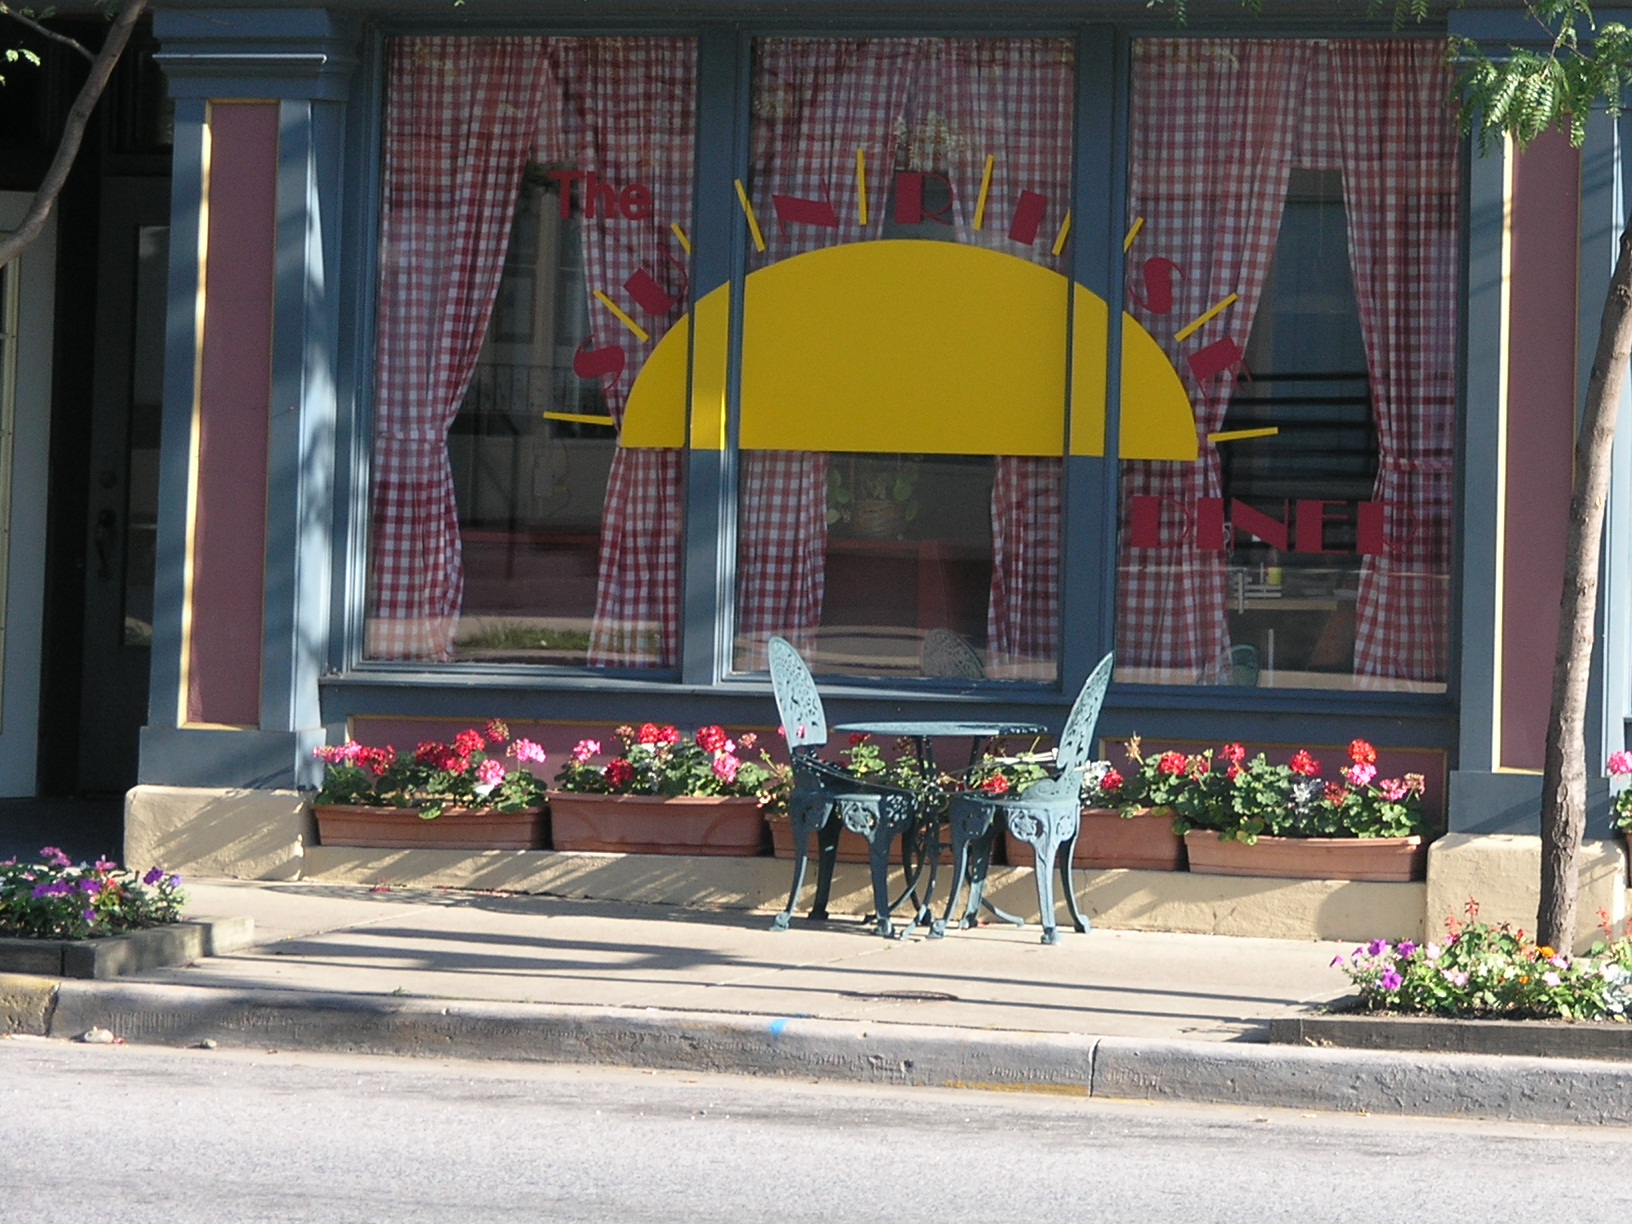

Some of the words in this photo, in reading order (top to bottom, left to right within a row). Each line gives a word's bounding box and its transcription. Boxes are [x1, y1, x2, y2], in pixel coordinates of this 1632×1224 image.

[550, 171, 652, 220] The
[573, 170, 1253, 398] SUNRISE
[1129, 495, 1416, 555] DINER
